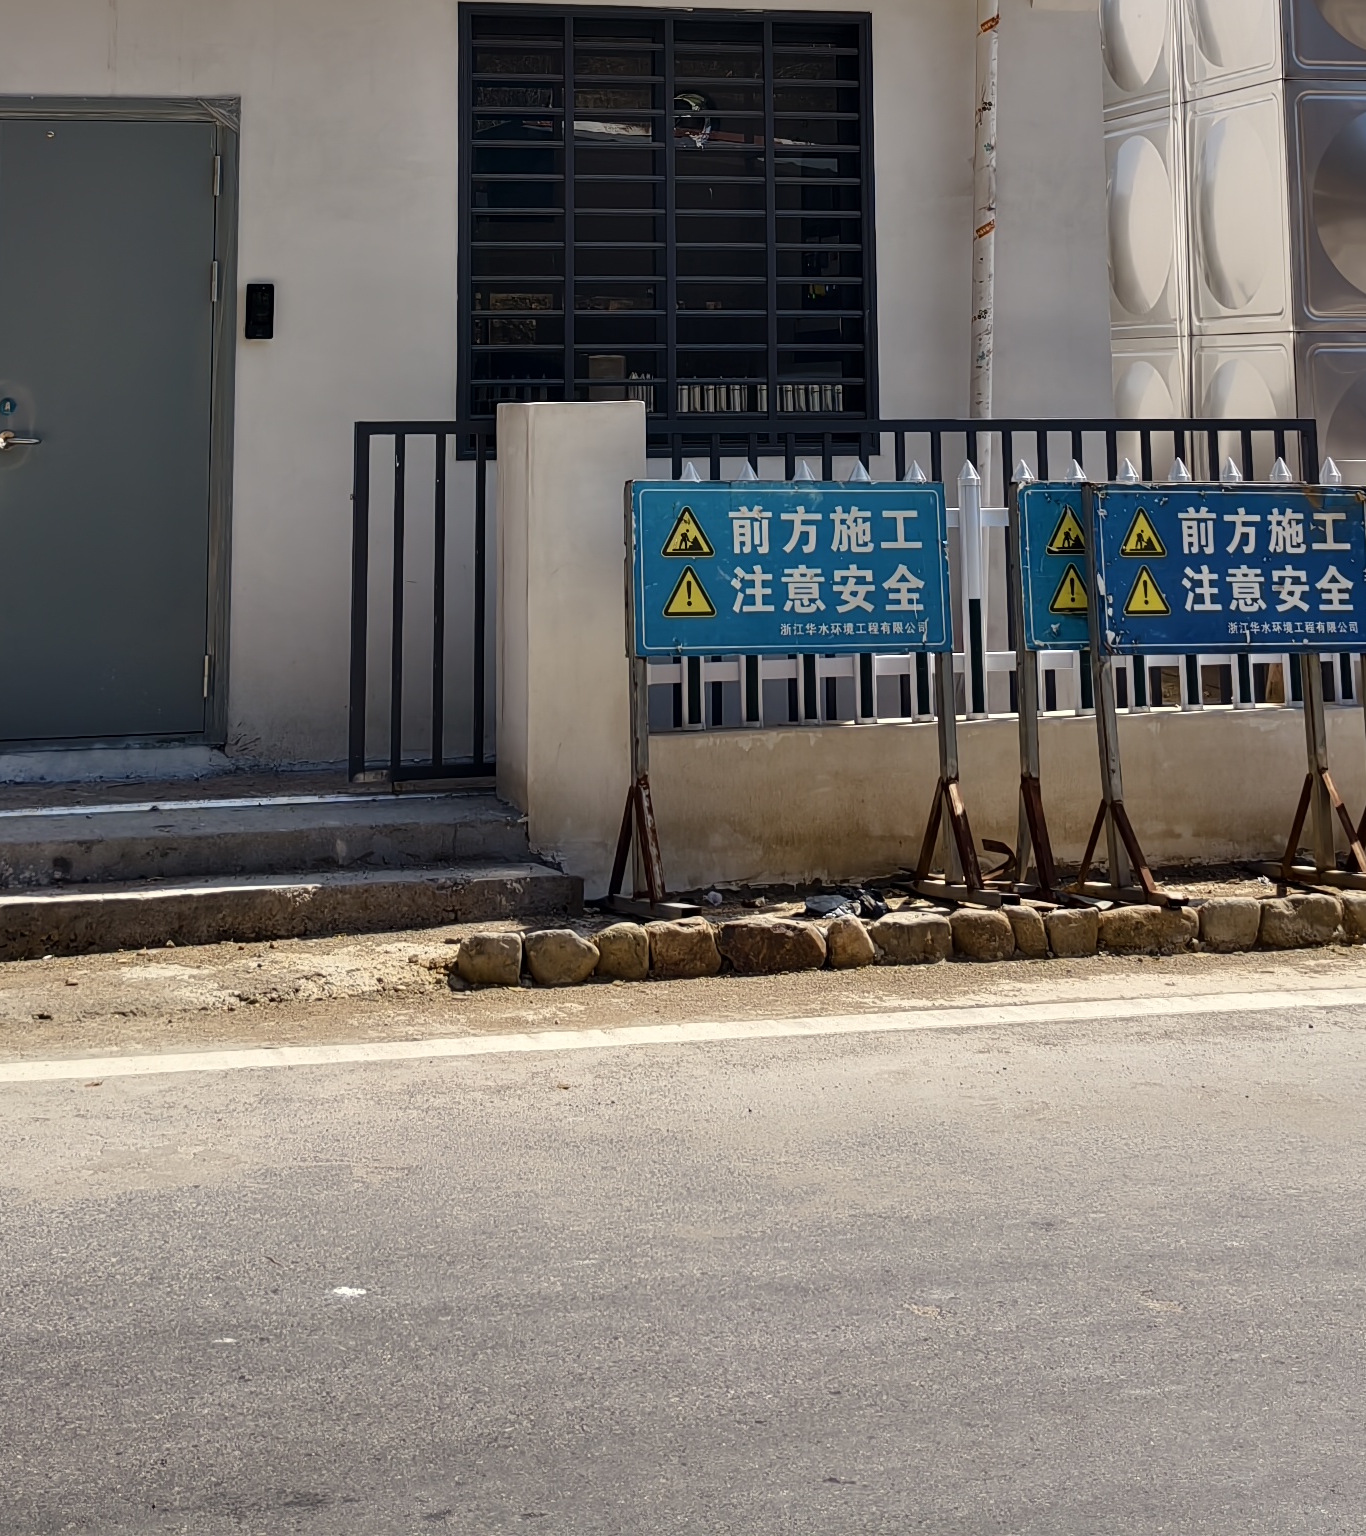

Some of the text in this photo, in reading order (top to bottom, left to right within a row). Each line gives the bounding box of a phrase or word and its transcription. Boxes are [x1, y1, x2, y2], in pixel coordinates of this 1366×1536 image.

[729, 506, 923, 554] 前方施工
[1177, 506, 1351, 554] 前方施工
[730, 564, 926, 614] 注意安全
[1181, 564, 1354, 613] 注意安全
[780, 621, 927, 635] 浙江华水环境工程有限公司
[1228, 621, 1358, 634] 浙江华水环境工程有限公司
